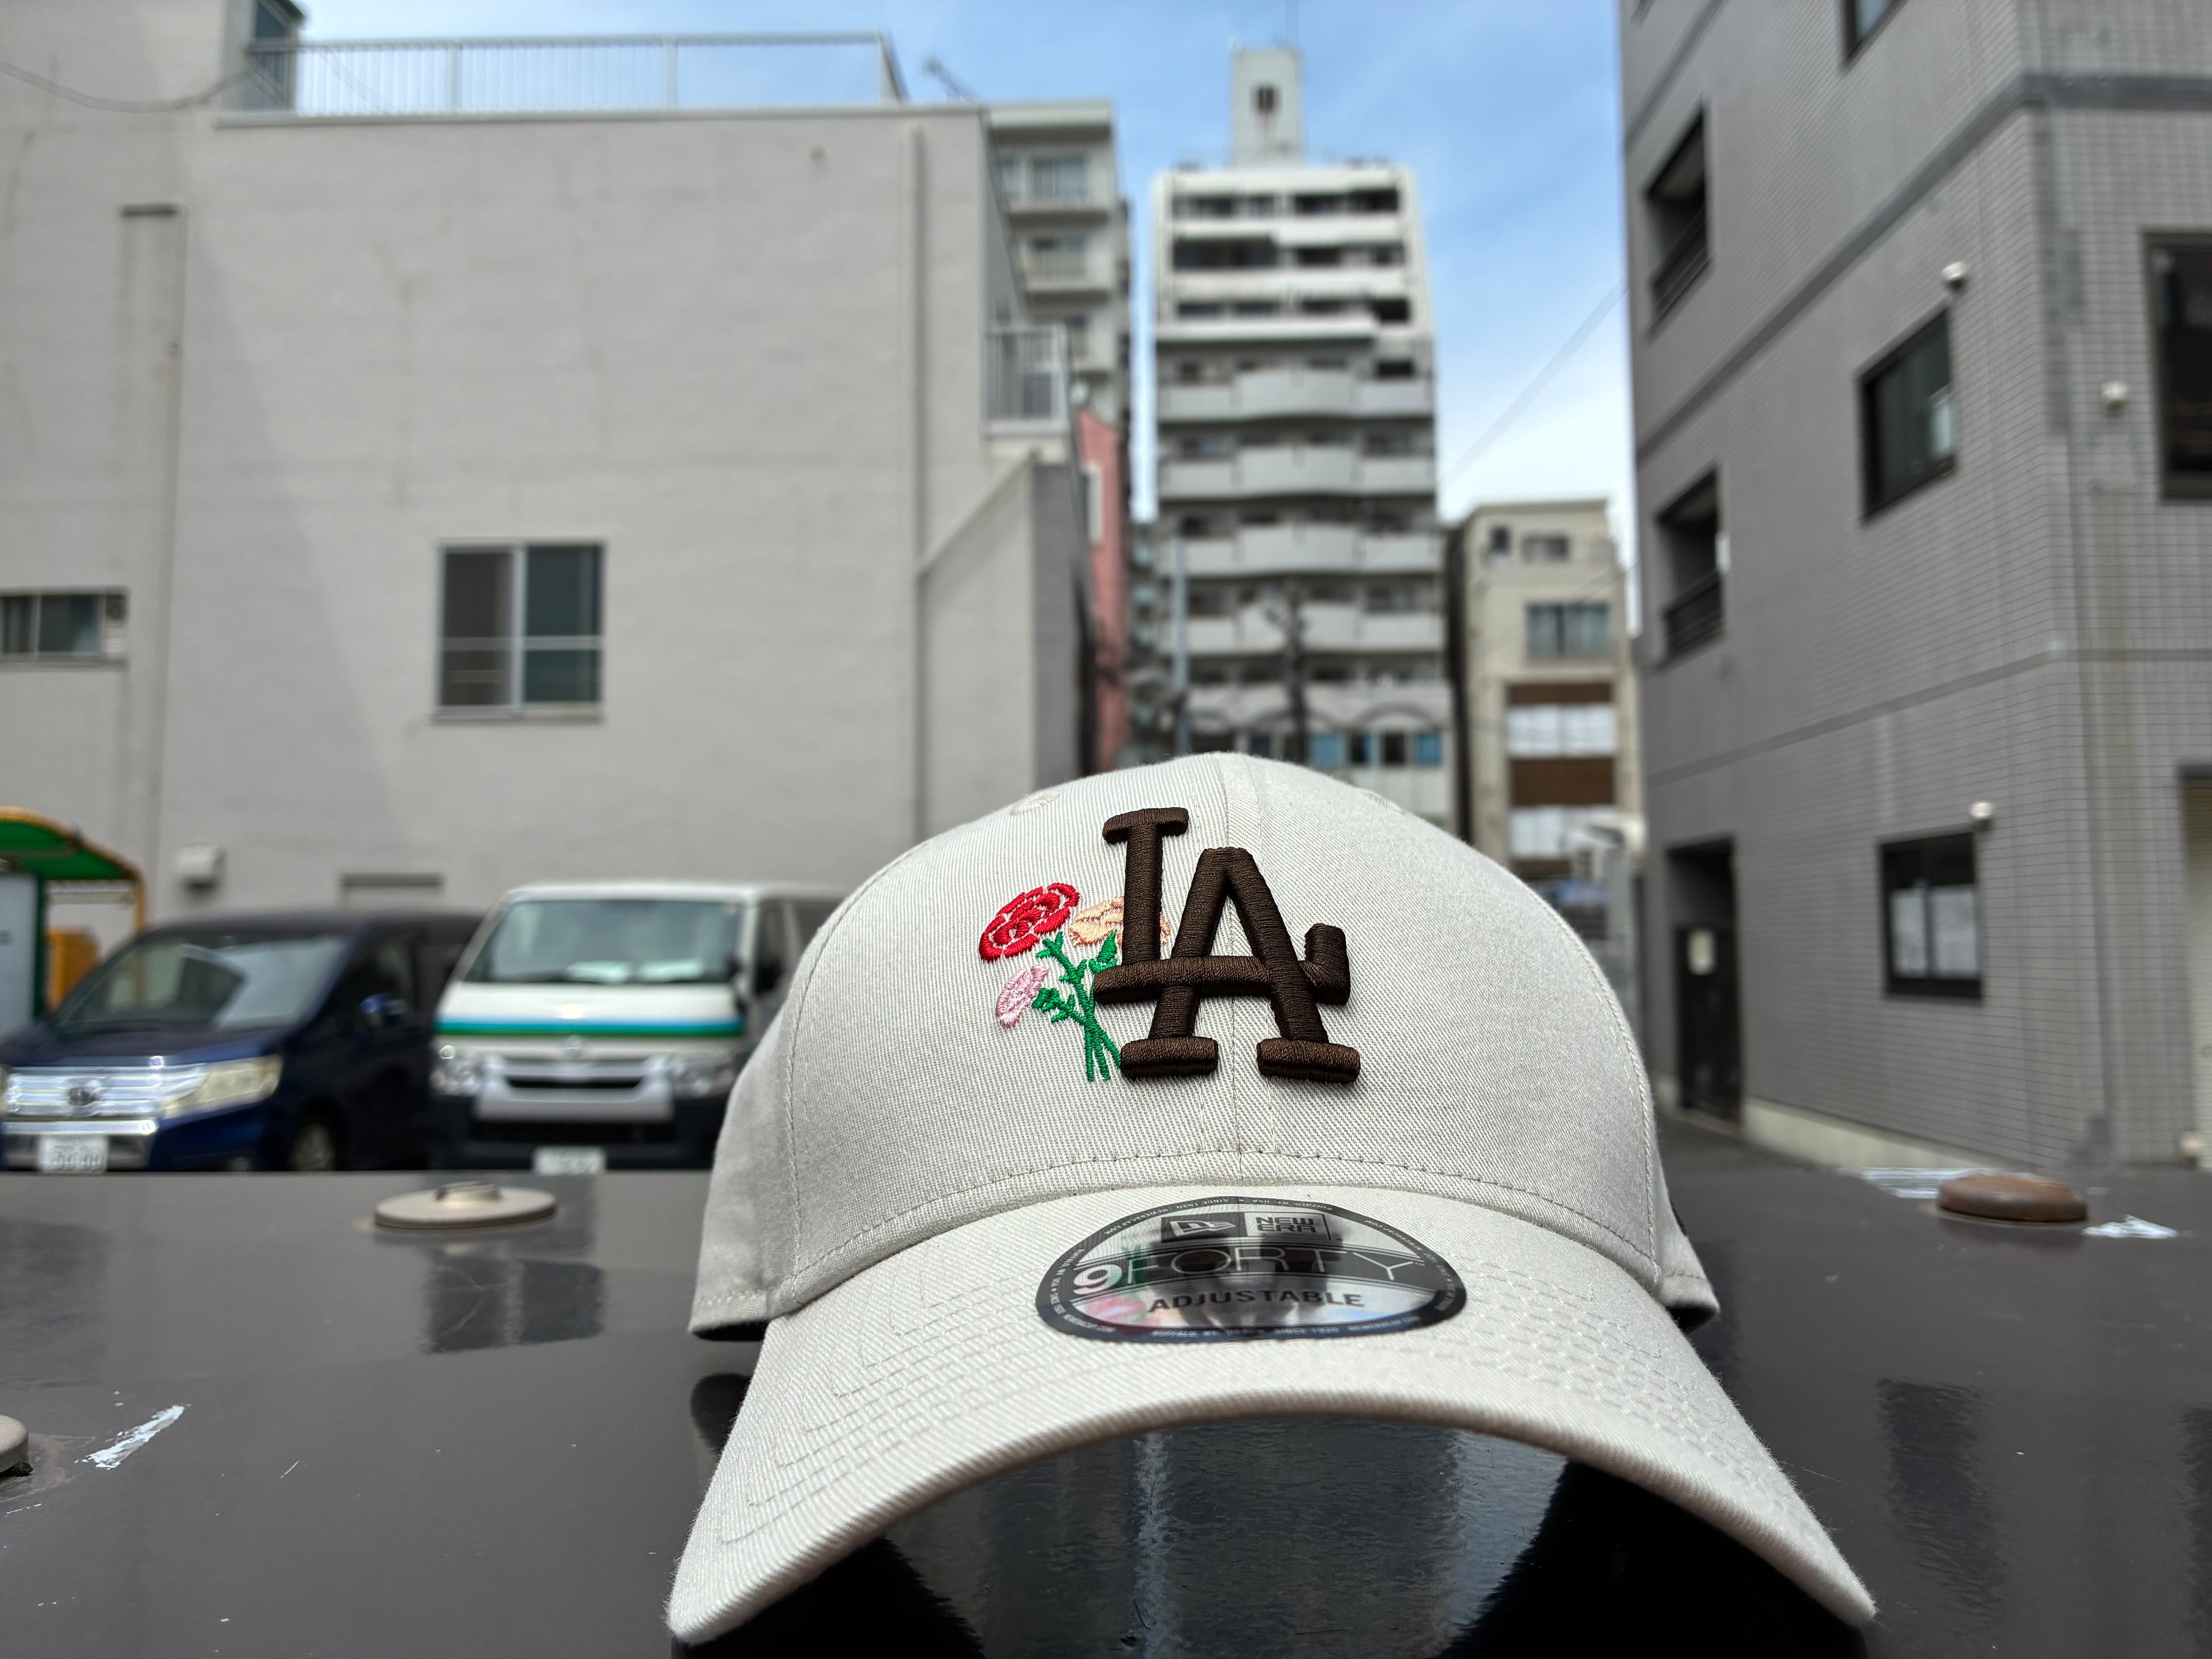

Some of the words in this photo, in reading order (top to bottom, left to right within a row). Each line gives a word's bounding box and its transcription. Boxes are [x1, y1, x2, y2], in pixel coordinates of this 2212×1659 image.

[1094, 807, 1360, 1083] LA
[1255, 1217, 1314, 1225] NEW
[1257, 1224, 1317, 1233] ERA
[1073, 1247, 1413, 1295] 9FORTY
[1148, 1289, 1364, 1313] ADJUSTABLE
